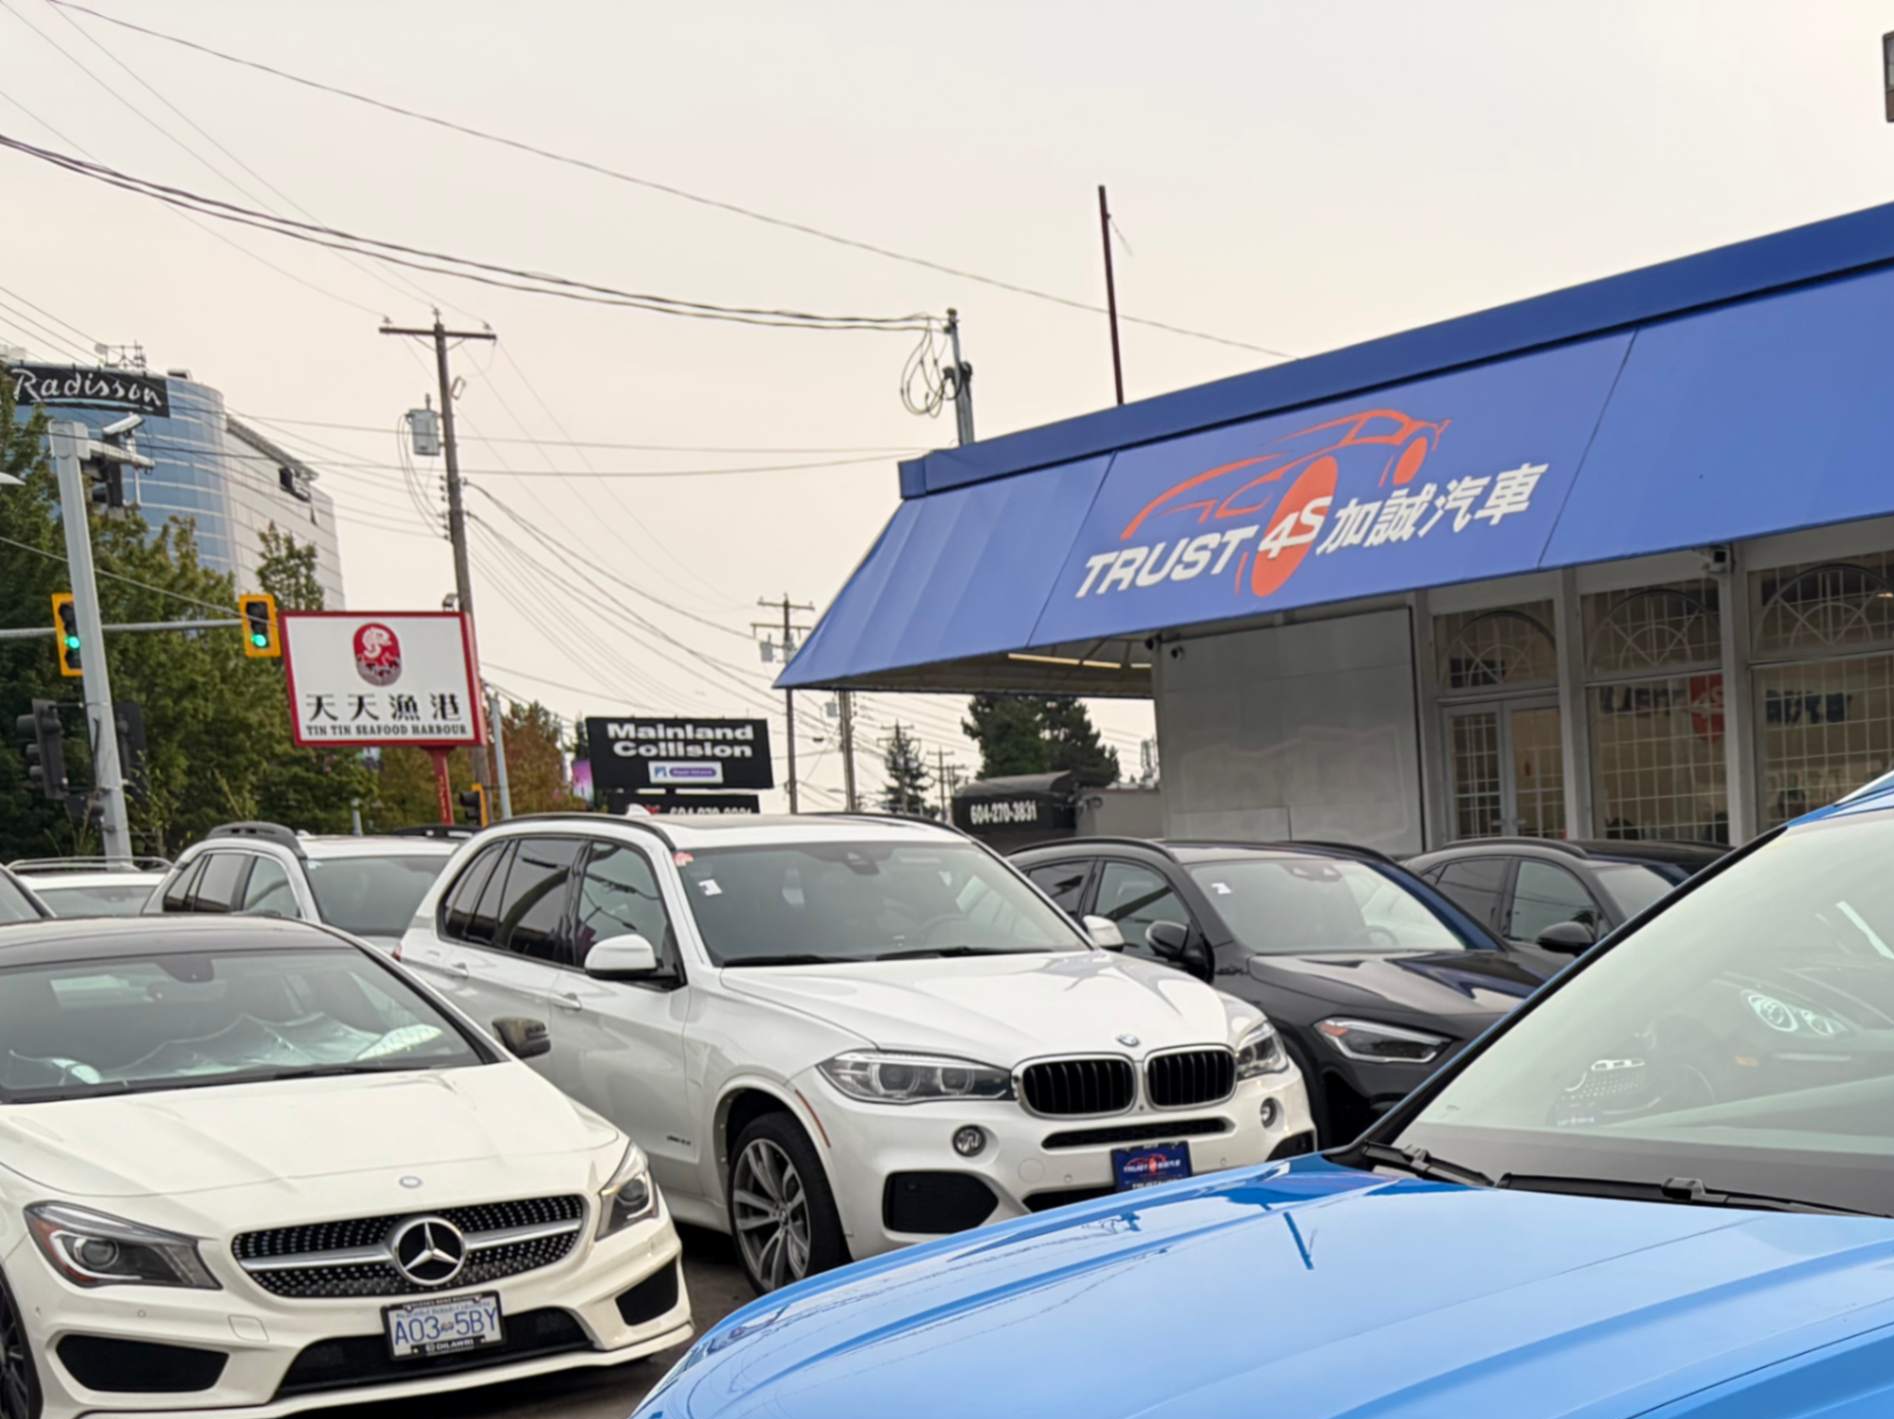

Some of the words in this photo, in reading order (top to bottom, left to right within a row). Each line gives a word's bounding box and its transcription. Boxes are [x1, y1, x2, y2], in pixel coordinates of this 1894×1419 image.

[11, 367, 161, 406] Radisson
[1316, 462, 1549, 556] 加誠汽車
[1075, 524, 1259, 599] TRUST
[1257, 496, 1333, 559] 4S
[306, 693, 461, 721] 天天漁港
[306, 725, 327, 736] TIN
[332, 725, 351, 735] TIN
[355, 724, 408, 735] SEAFOOD
[412, 723, 467, 735] HARBOUR
[606, 722, 754, 740] Mainland
[613, 740, 753, 757] Collision
[970, 801, 1037, 824] 604-270-3831
